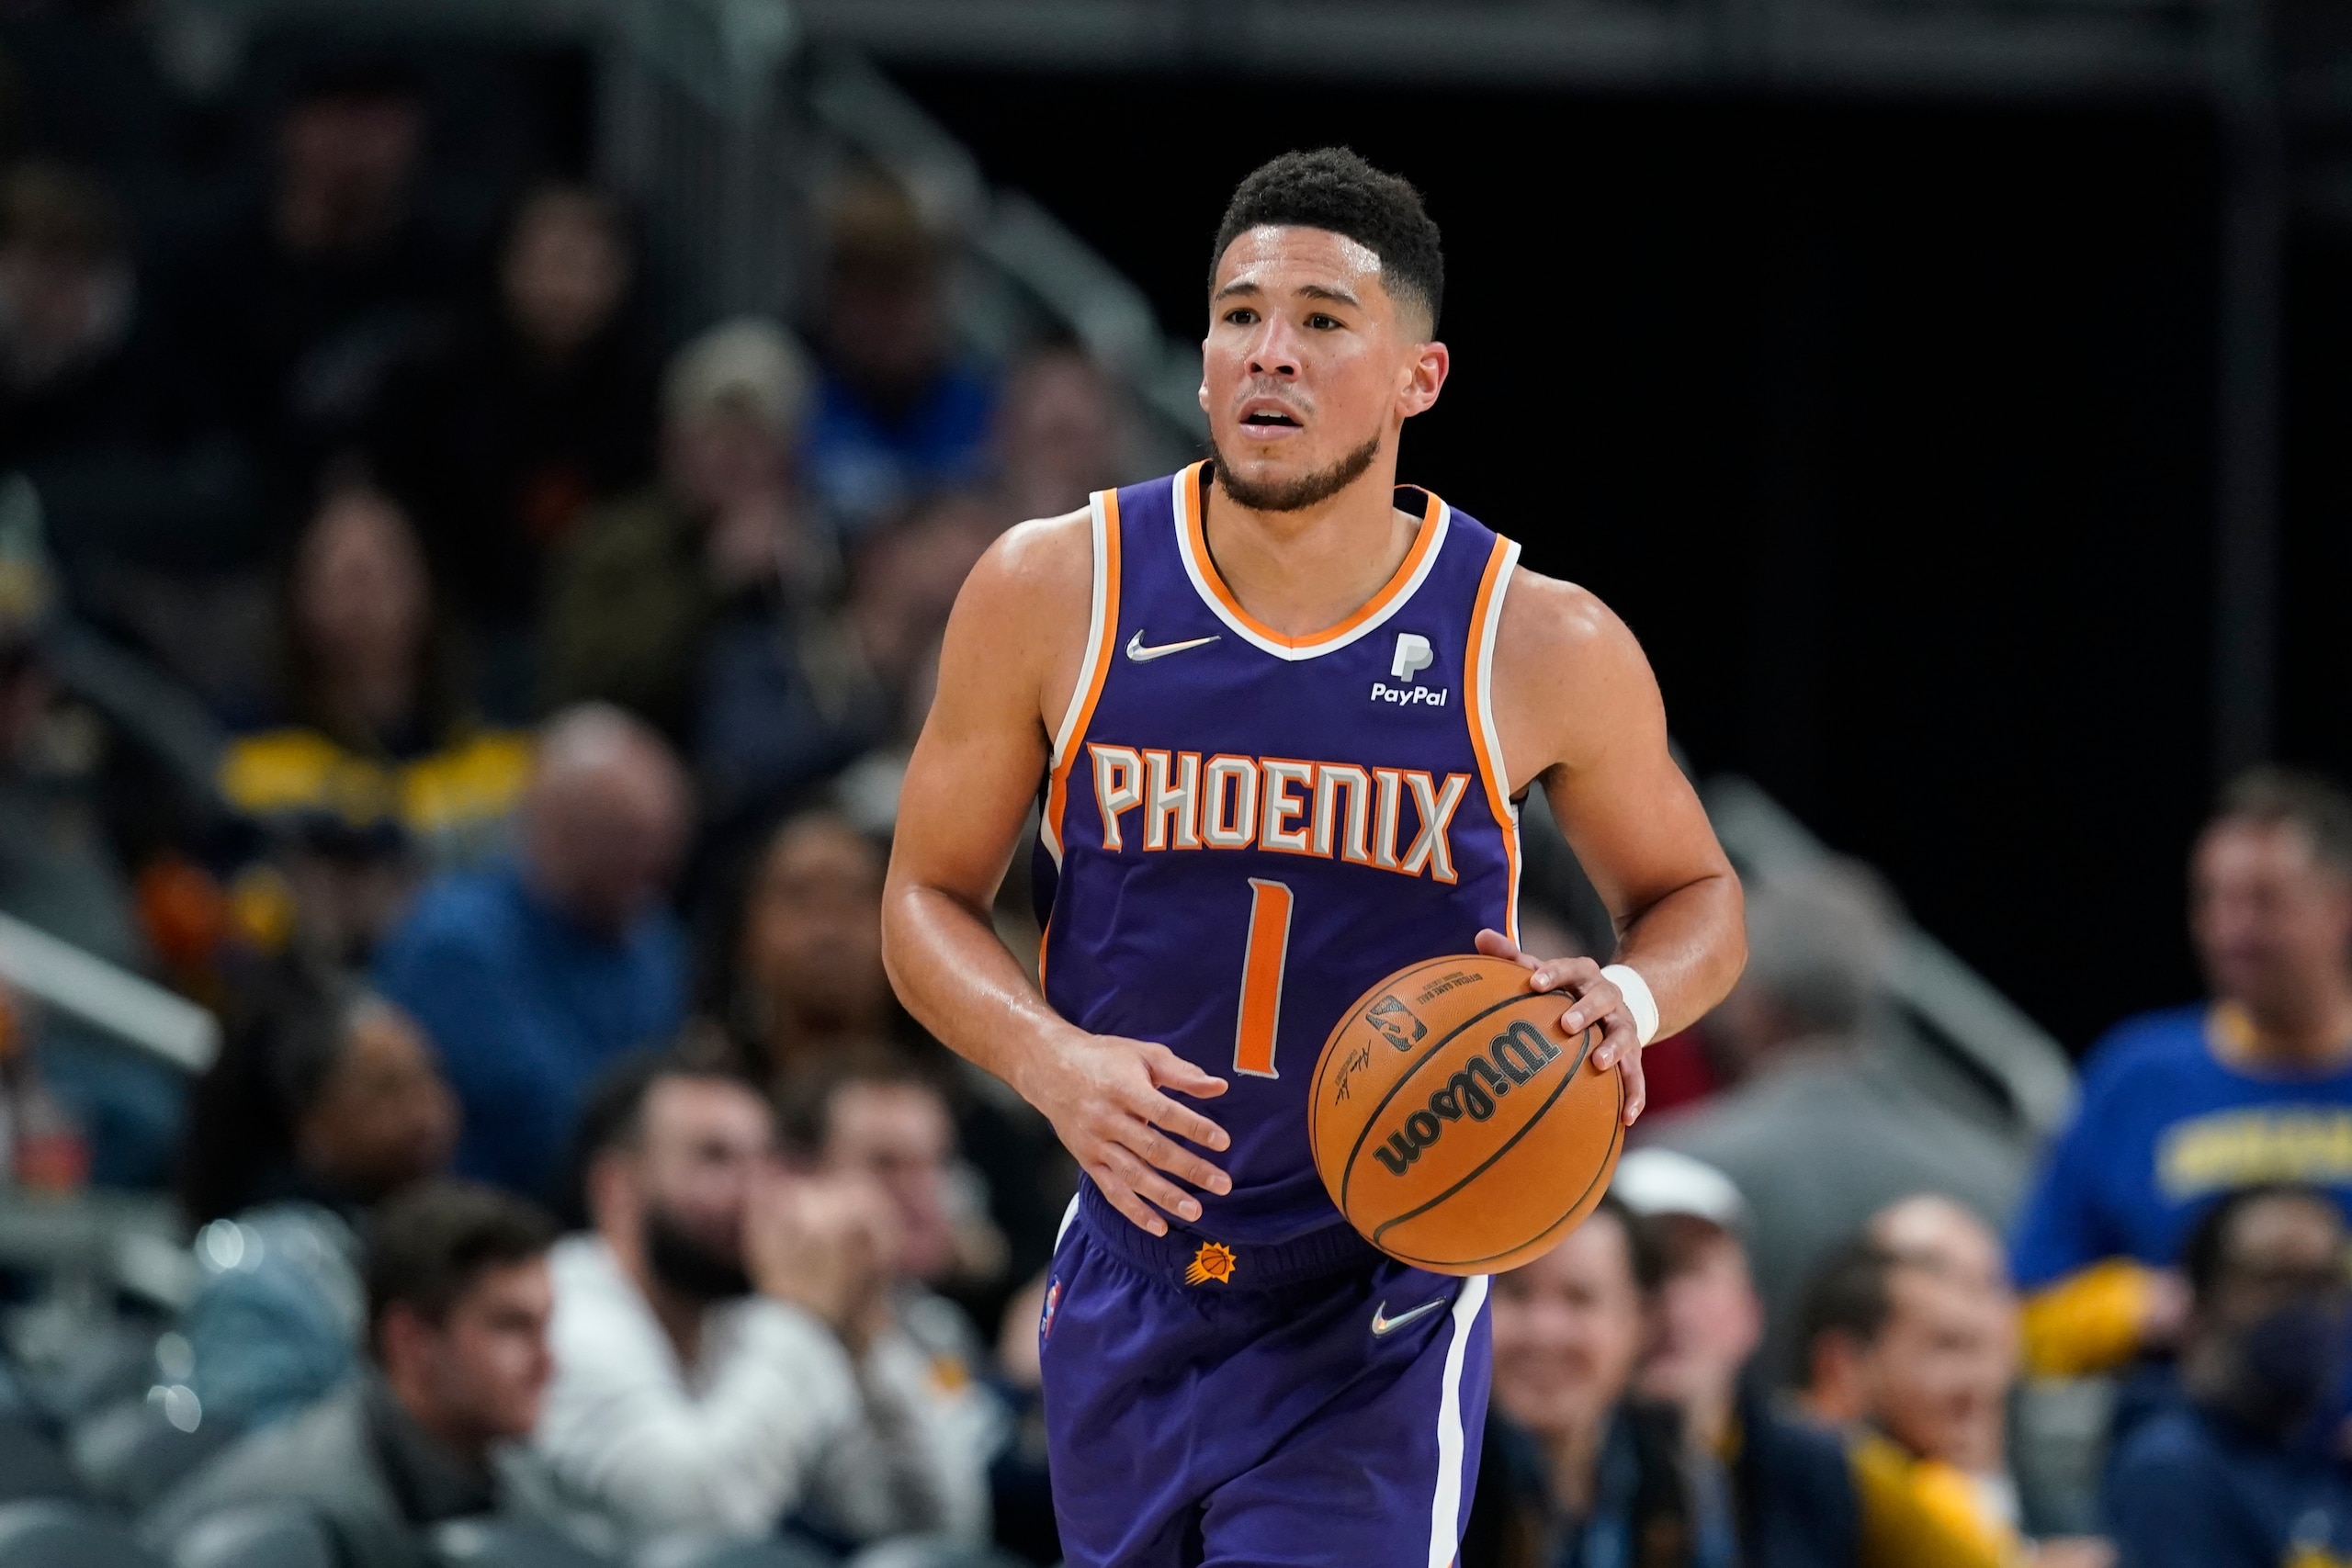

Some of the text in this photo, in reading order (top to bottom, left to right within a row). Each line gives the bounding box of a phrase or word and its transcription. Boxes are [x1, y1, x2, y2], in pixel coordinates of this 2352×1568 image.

[1371, 682, 1448, 706] PayPal
[1086, 742, 1472, 885] PHOENIX
[1233, 877, 1294, 1079] 1
[1373, 1020, 1562, 1176] Wilson
